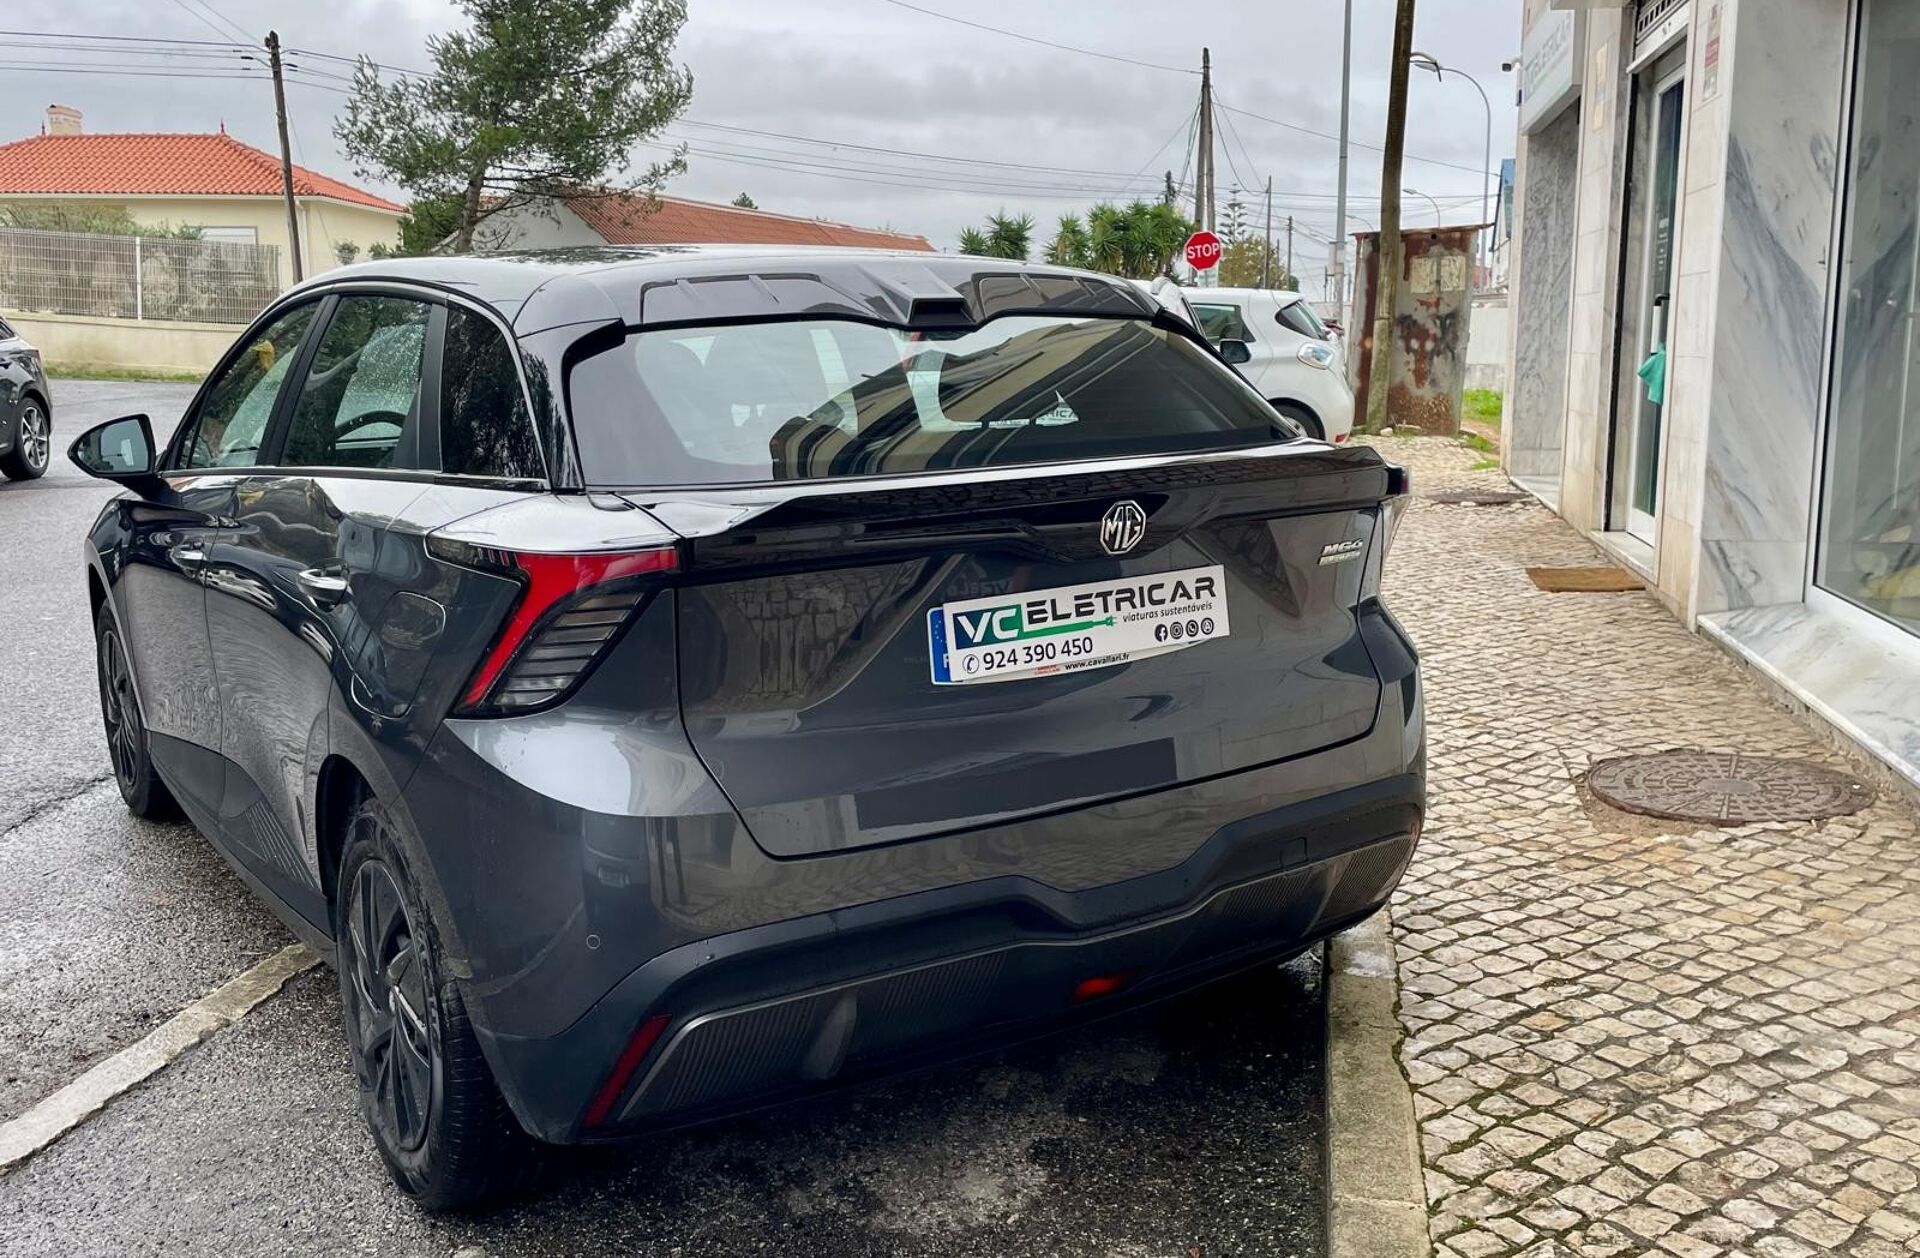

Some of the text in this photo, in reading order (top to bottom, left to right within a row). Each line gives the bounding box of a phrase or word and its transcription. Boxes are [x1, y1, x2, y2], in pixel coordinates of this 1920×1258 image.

[1187, 242, 1220, 259] STOP
[1105, 506, 1141, 550] MG
[1123, 601, 1213, 622] viaturas sustentáveis
[983, 649, 1018, 670] 924
[1023, 643, 1056, 664] 390
[1061, 637, 1093, 657] 450
[1065, 653, 1130, 670] www.cavallari.fr
